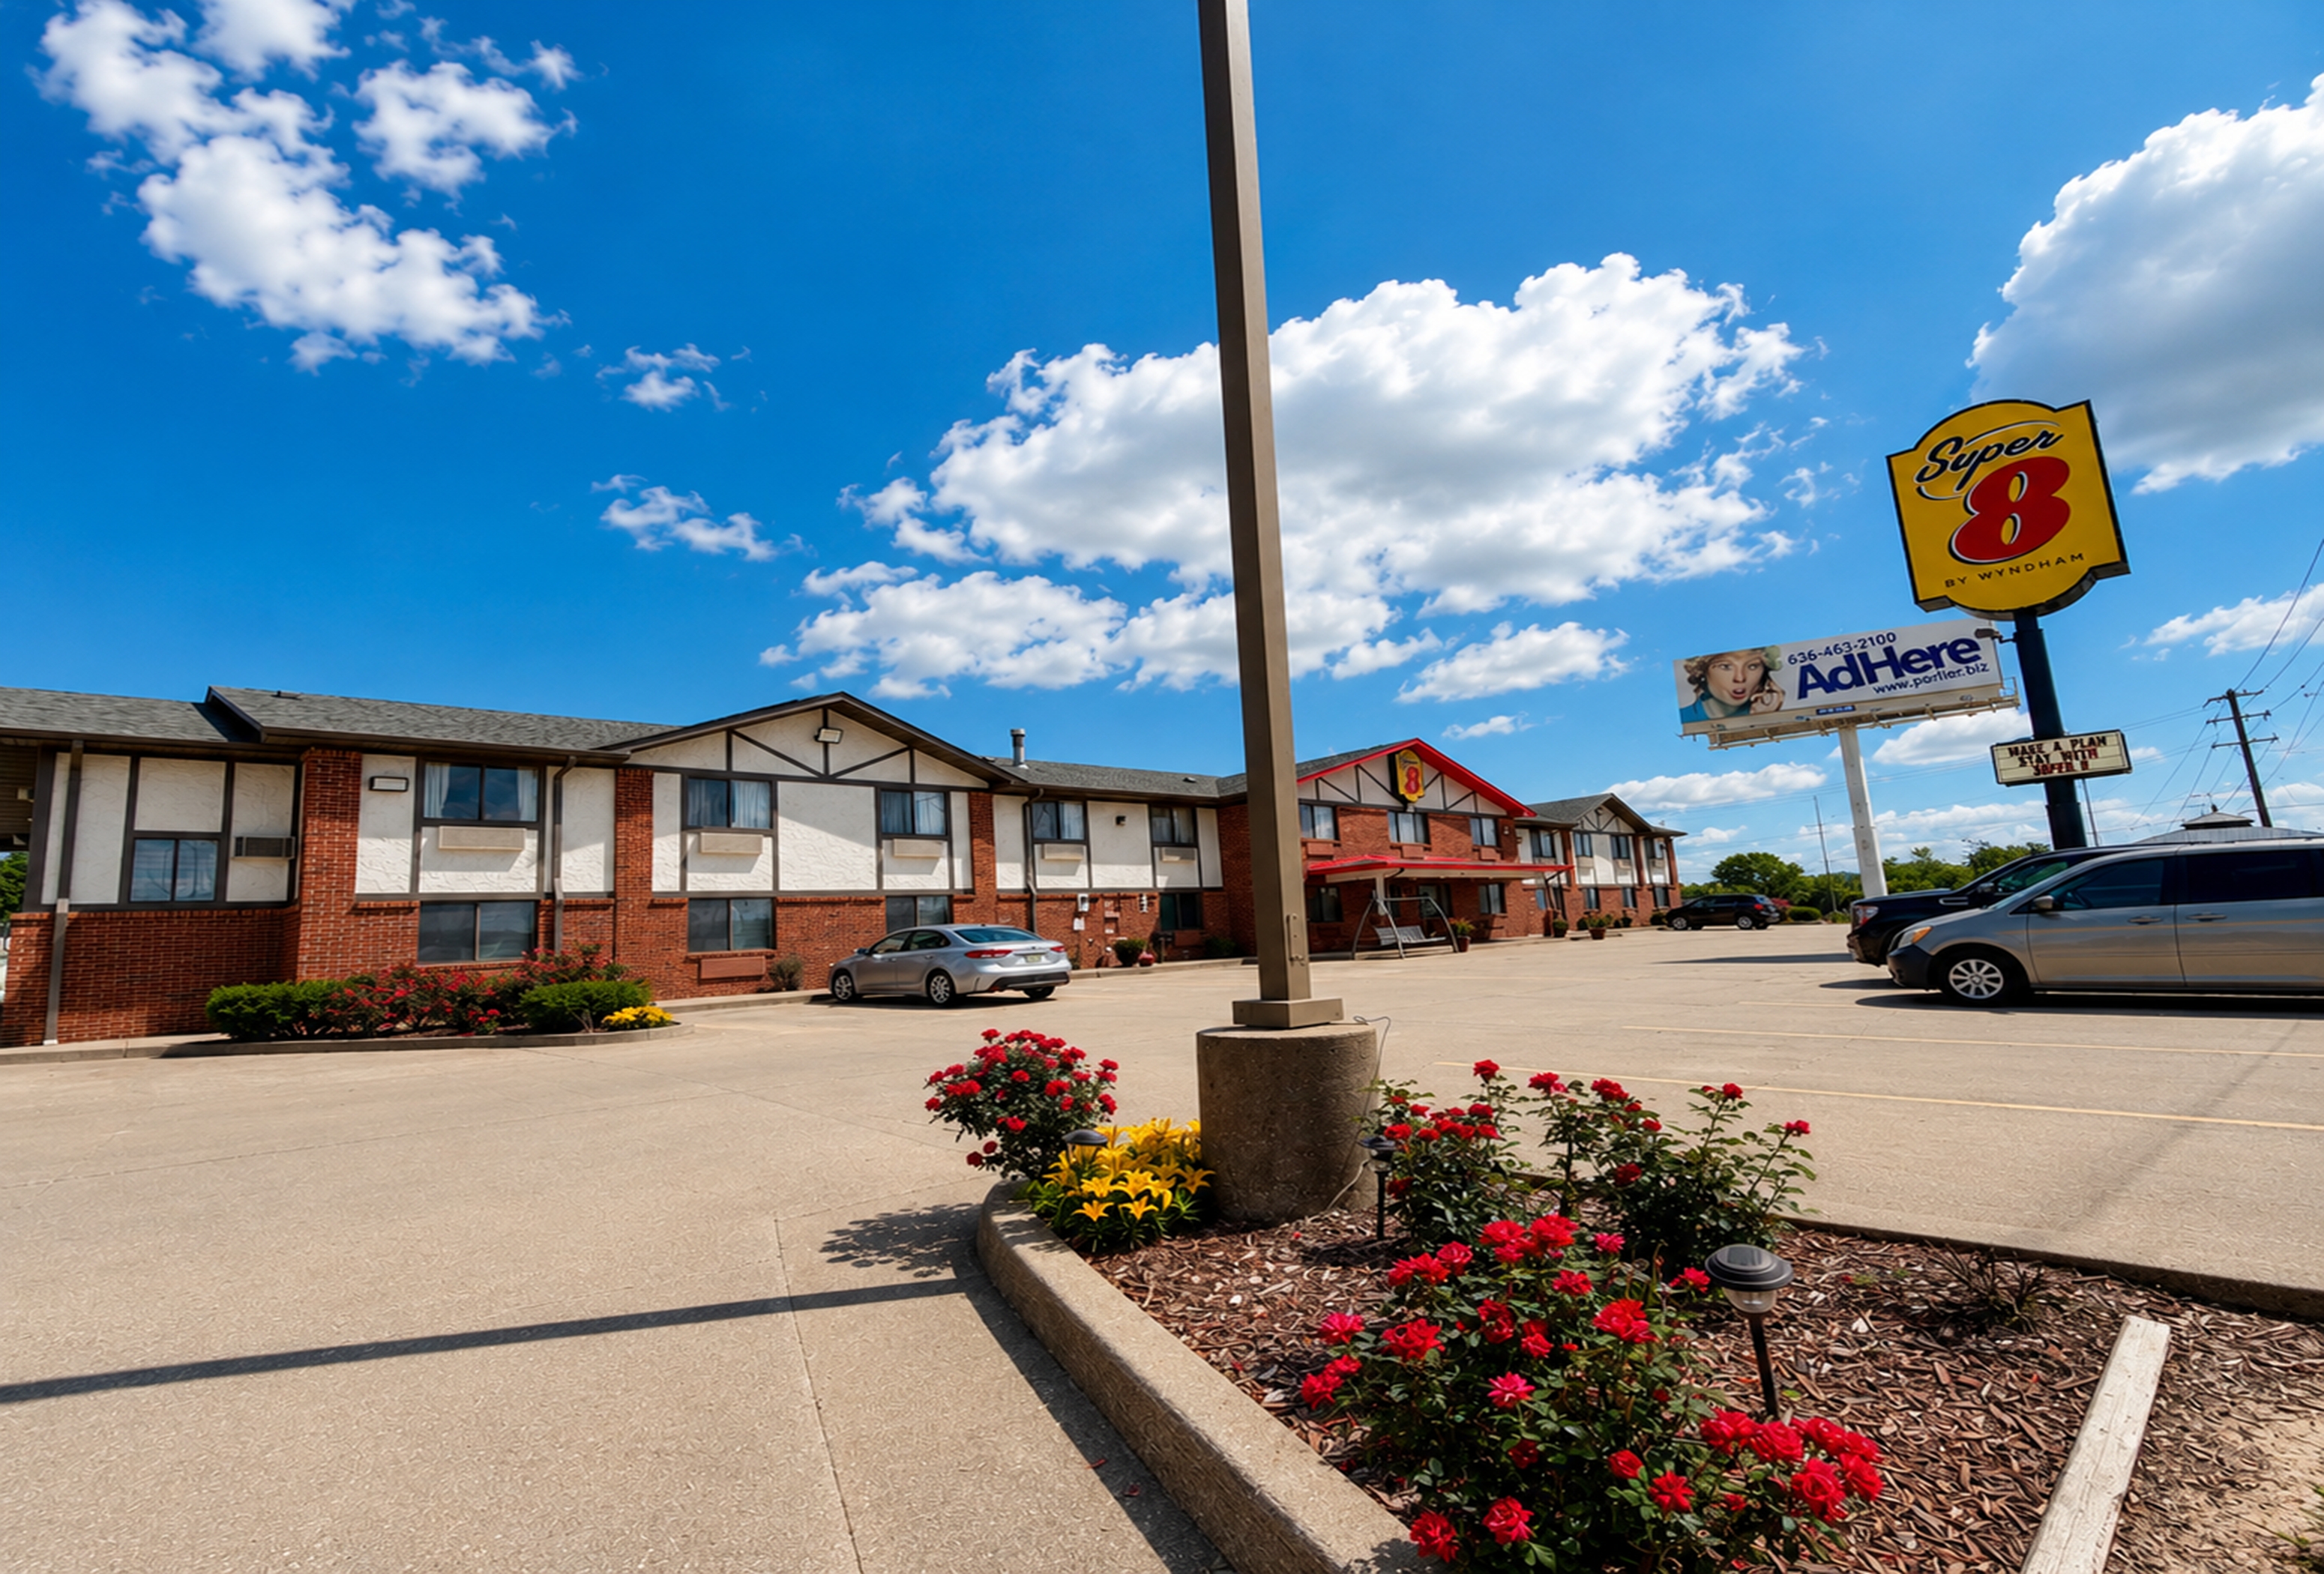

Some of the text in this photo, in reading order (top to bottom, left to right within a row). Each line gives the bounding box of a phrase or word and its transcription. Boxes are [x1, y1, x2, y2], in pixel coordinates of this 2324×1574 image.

[1915, 429, 2064, 492] Super
[1948, 456, 2071, 565] 8
[1945, 552, 2084, 588] BY WYNDHAM
[1787, 632, 1897, 666] 636-463-2100
[1797, 638, 1982, 700] AdHere
[2053, 741, 2063, 752] A
[2070, 736, 2107, 751] PLAN
